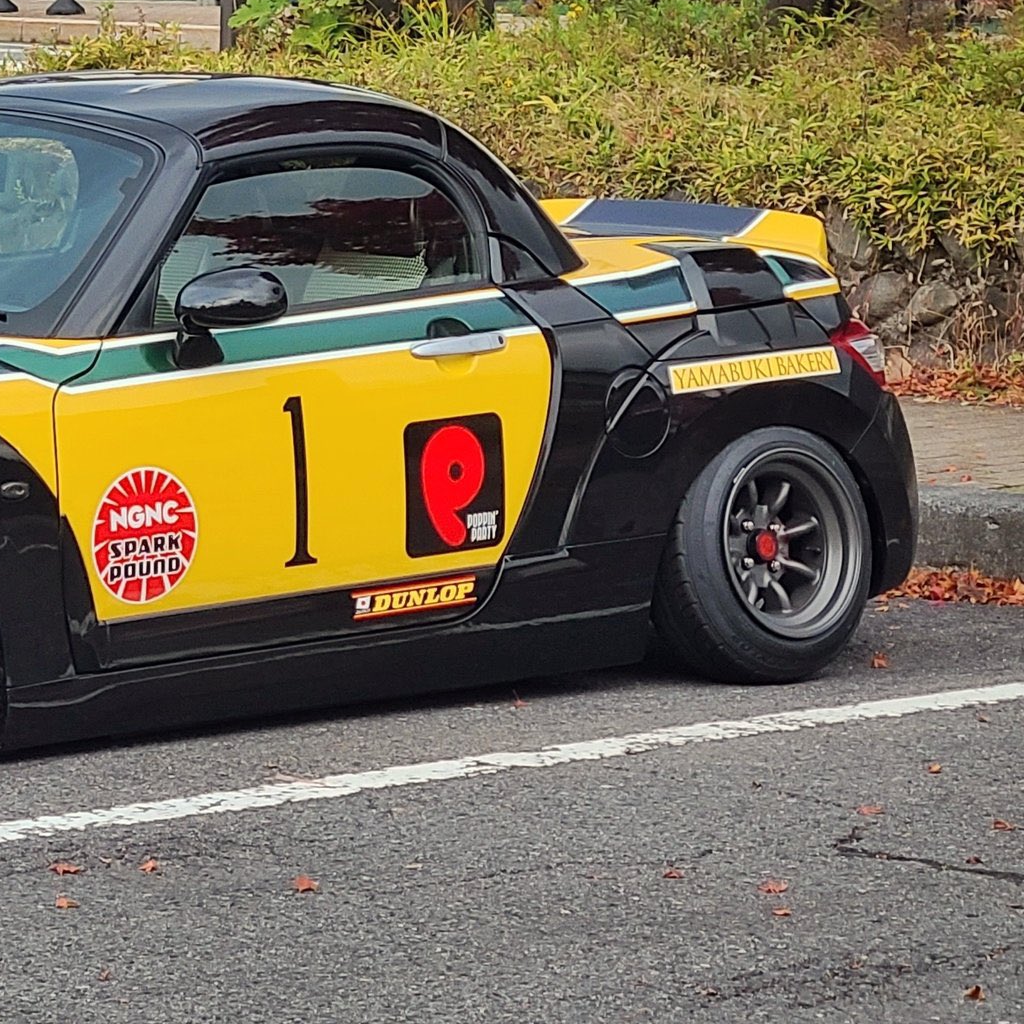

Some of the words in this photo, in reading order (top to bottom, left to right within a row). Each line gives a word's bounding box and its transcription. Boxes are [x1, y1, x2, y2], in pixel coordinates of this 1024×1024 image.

[672, 357, 772, 390] YAMABUKI
[776, 350, 835, 376] BAKERY
[109, 499, 179, 532] NGNC
[109, 533, 181, 559] SPARK
[109, 556, 181, 582] POUND
[371, 582, 475, 612] DUNLOP
